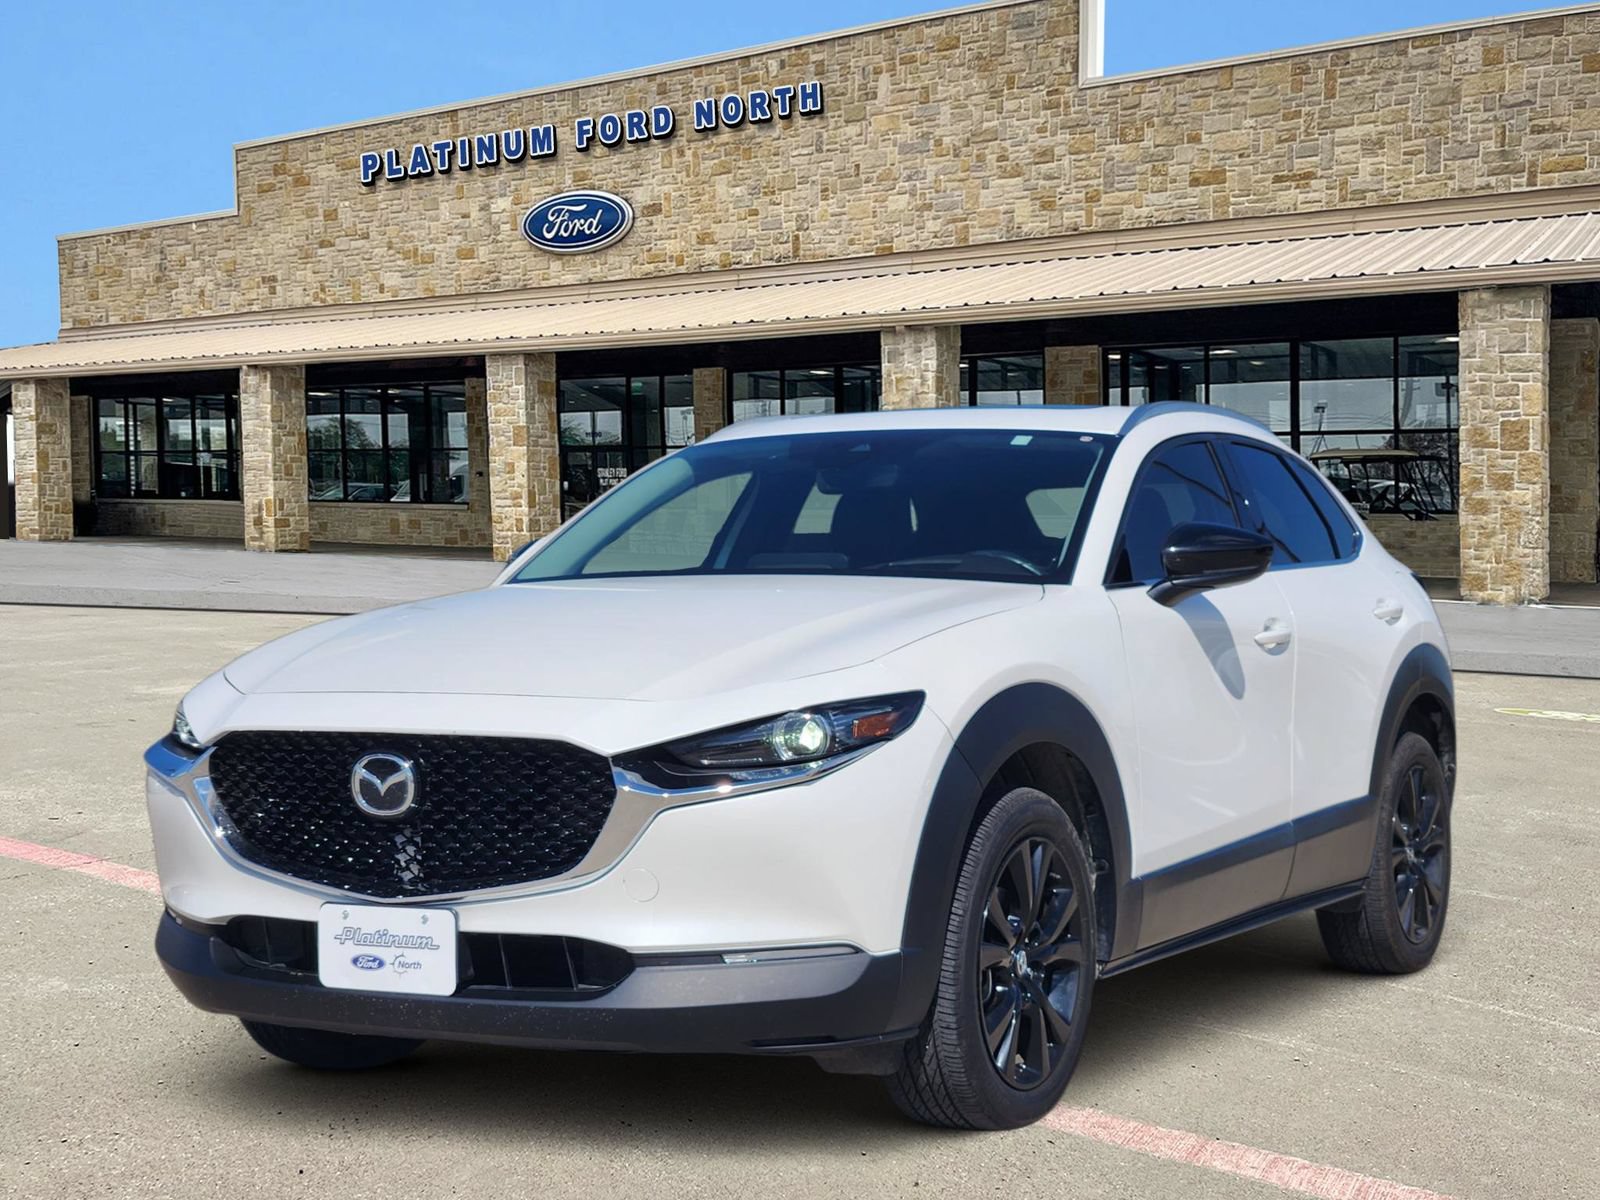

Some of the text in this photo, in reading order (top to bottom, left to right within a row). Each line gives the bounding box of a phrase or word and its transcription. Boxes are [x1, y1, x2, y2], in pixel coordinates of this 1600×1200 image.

[361, 81, 823, 185] PLATINUM FORD NORTH
[541, 203, 603, 240] Ford
[334, 926, 440, 950] Platinum
[355, 954, 422, 970] Ford North
